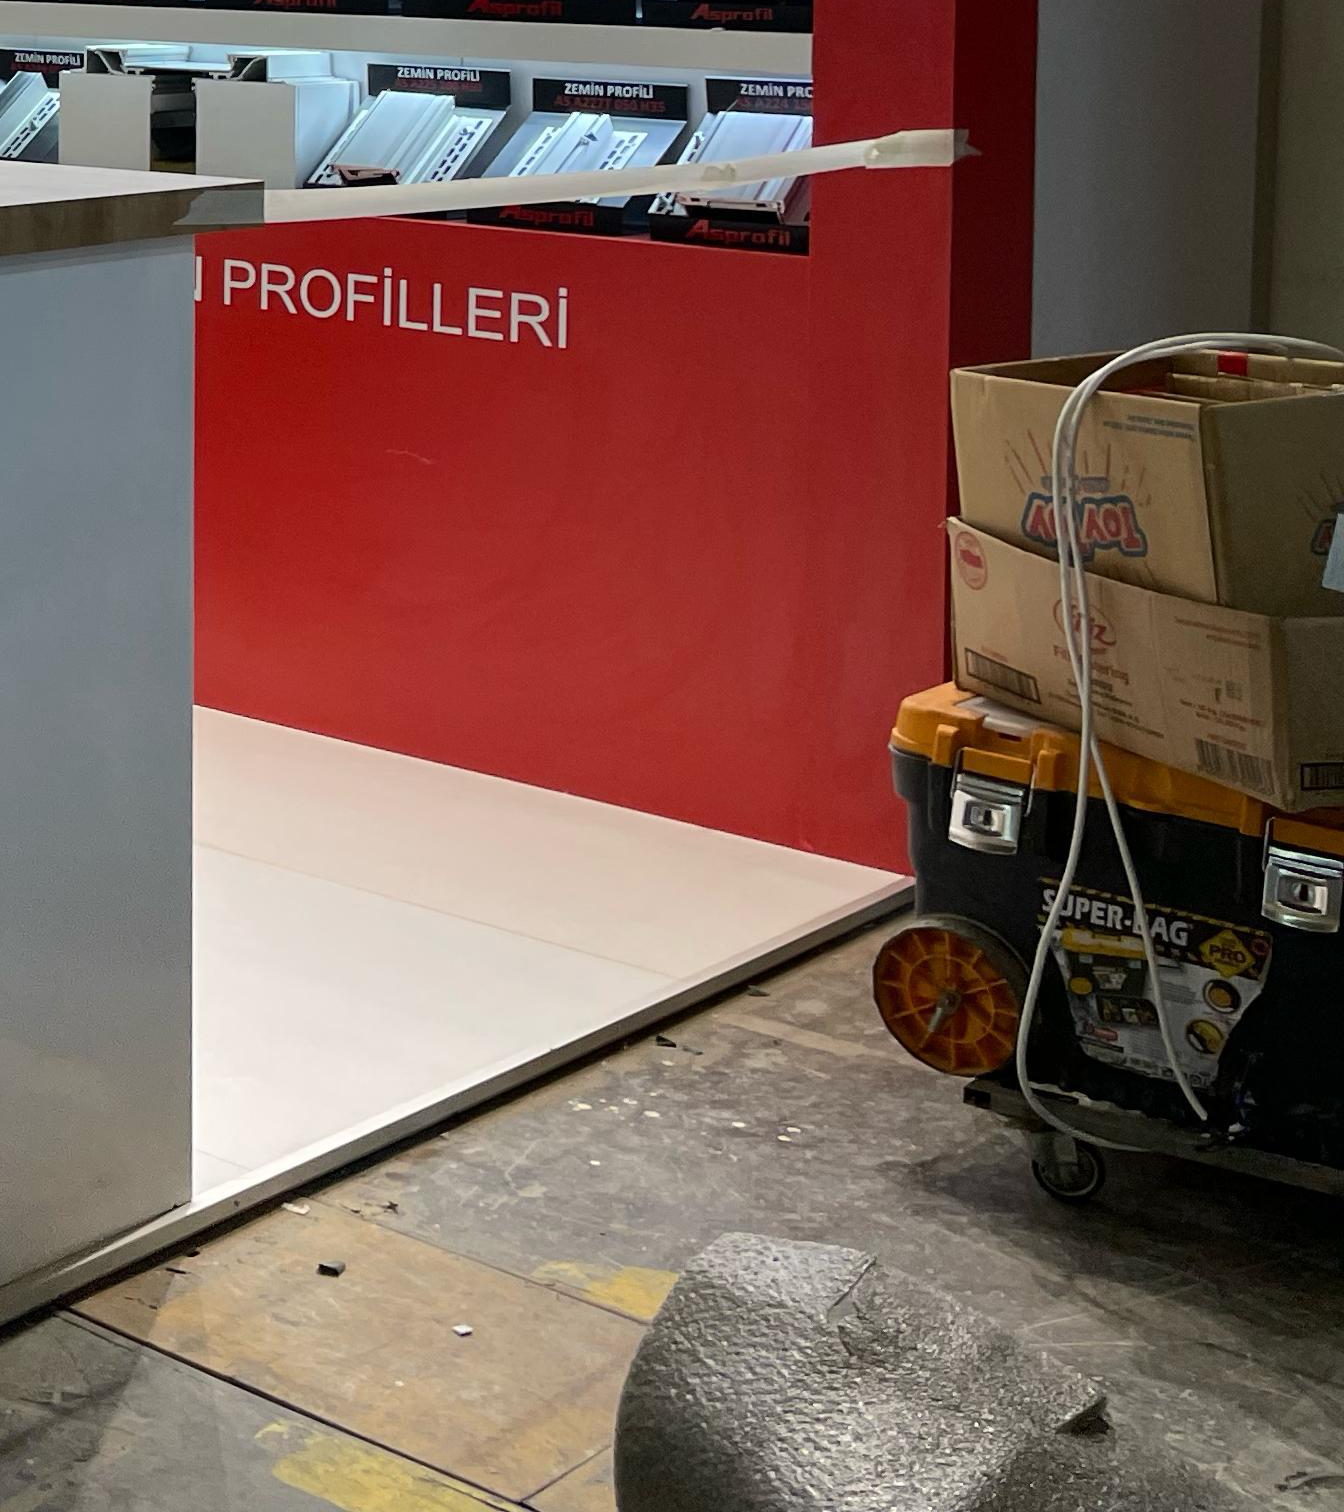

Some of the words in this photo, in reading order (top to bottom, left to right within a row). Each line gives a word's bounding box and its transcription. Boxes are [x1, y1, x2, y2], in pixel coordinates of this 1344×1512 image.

[690, 1, 773, 23] Asprofil
[14, 51, 45, 64] ZEMİN
[45, 53, 81, 66] PROFİLİ
[396, 66, 435, 80] ZEMİN
[436, 68, 480, 82] PROFİLİ
[563, 81, 604, 96] ZEMİN
[606, 83, 654, 99] PROFİLİ
[739, 82, 784, 97] ZEMİN
[686, 219, 791, 248] Asprofil
[222, 258, 570, 350] PROFİLLERİ
[1208, 943, 1247, 965] PRO
